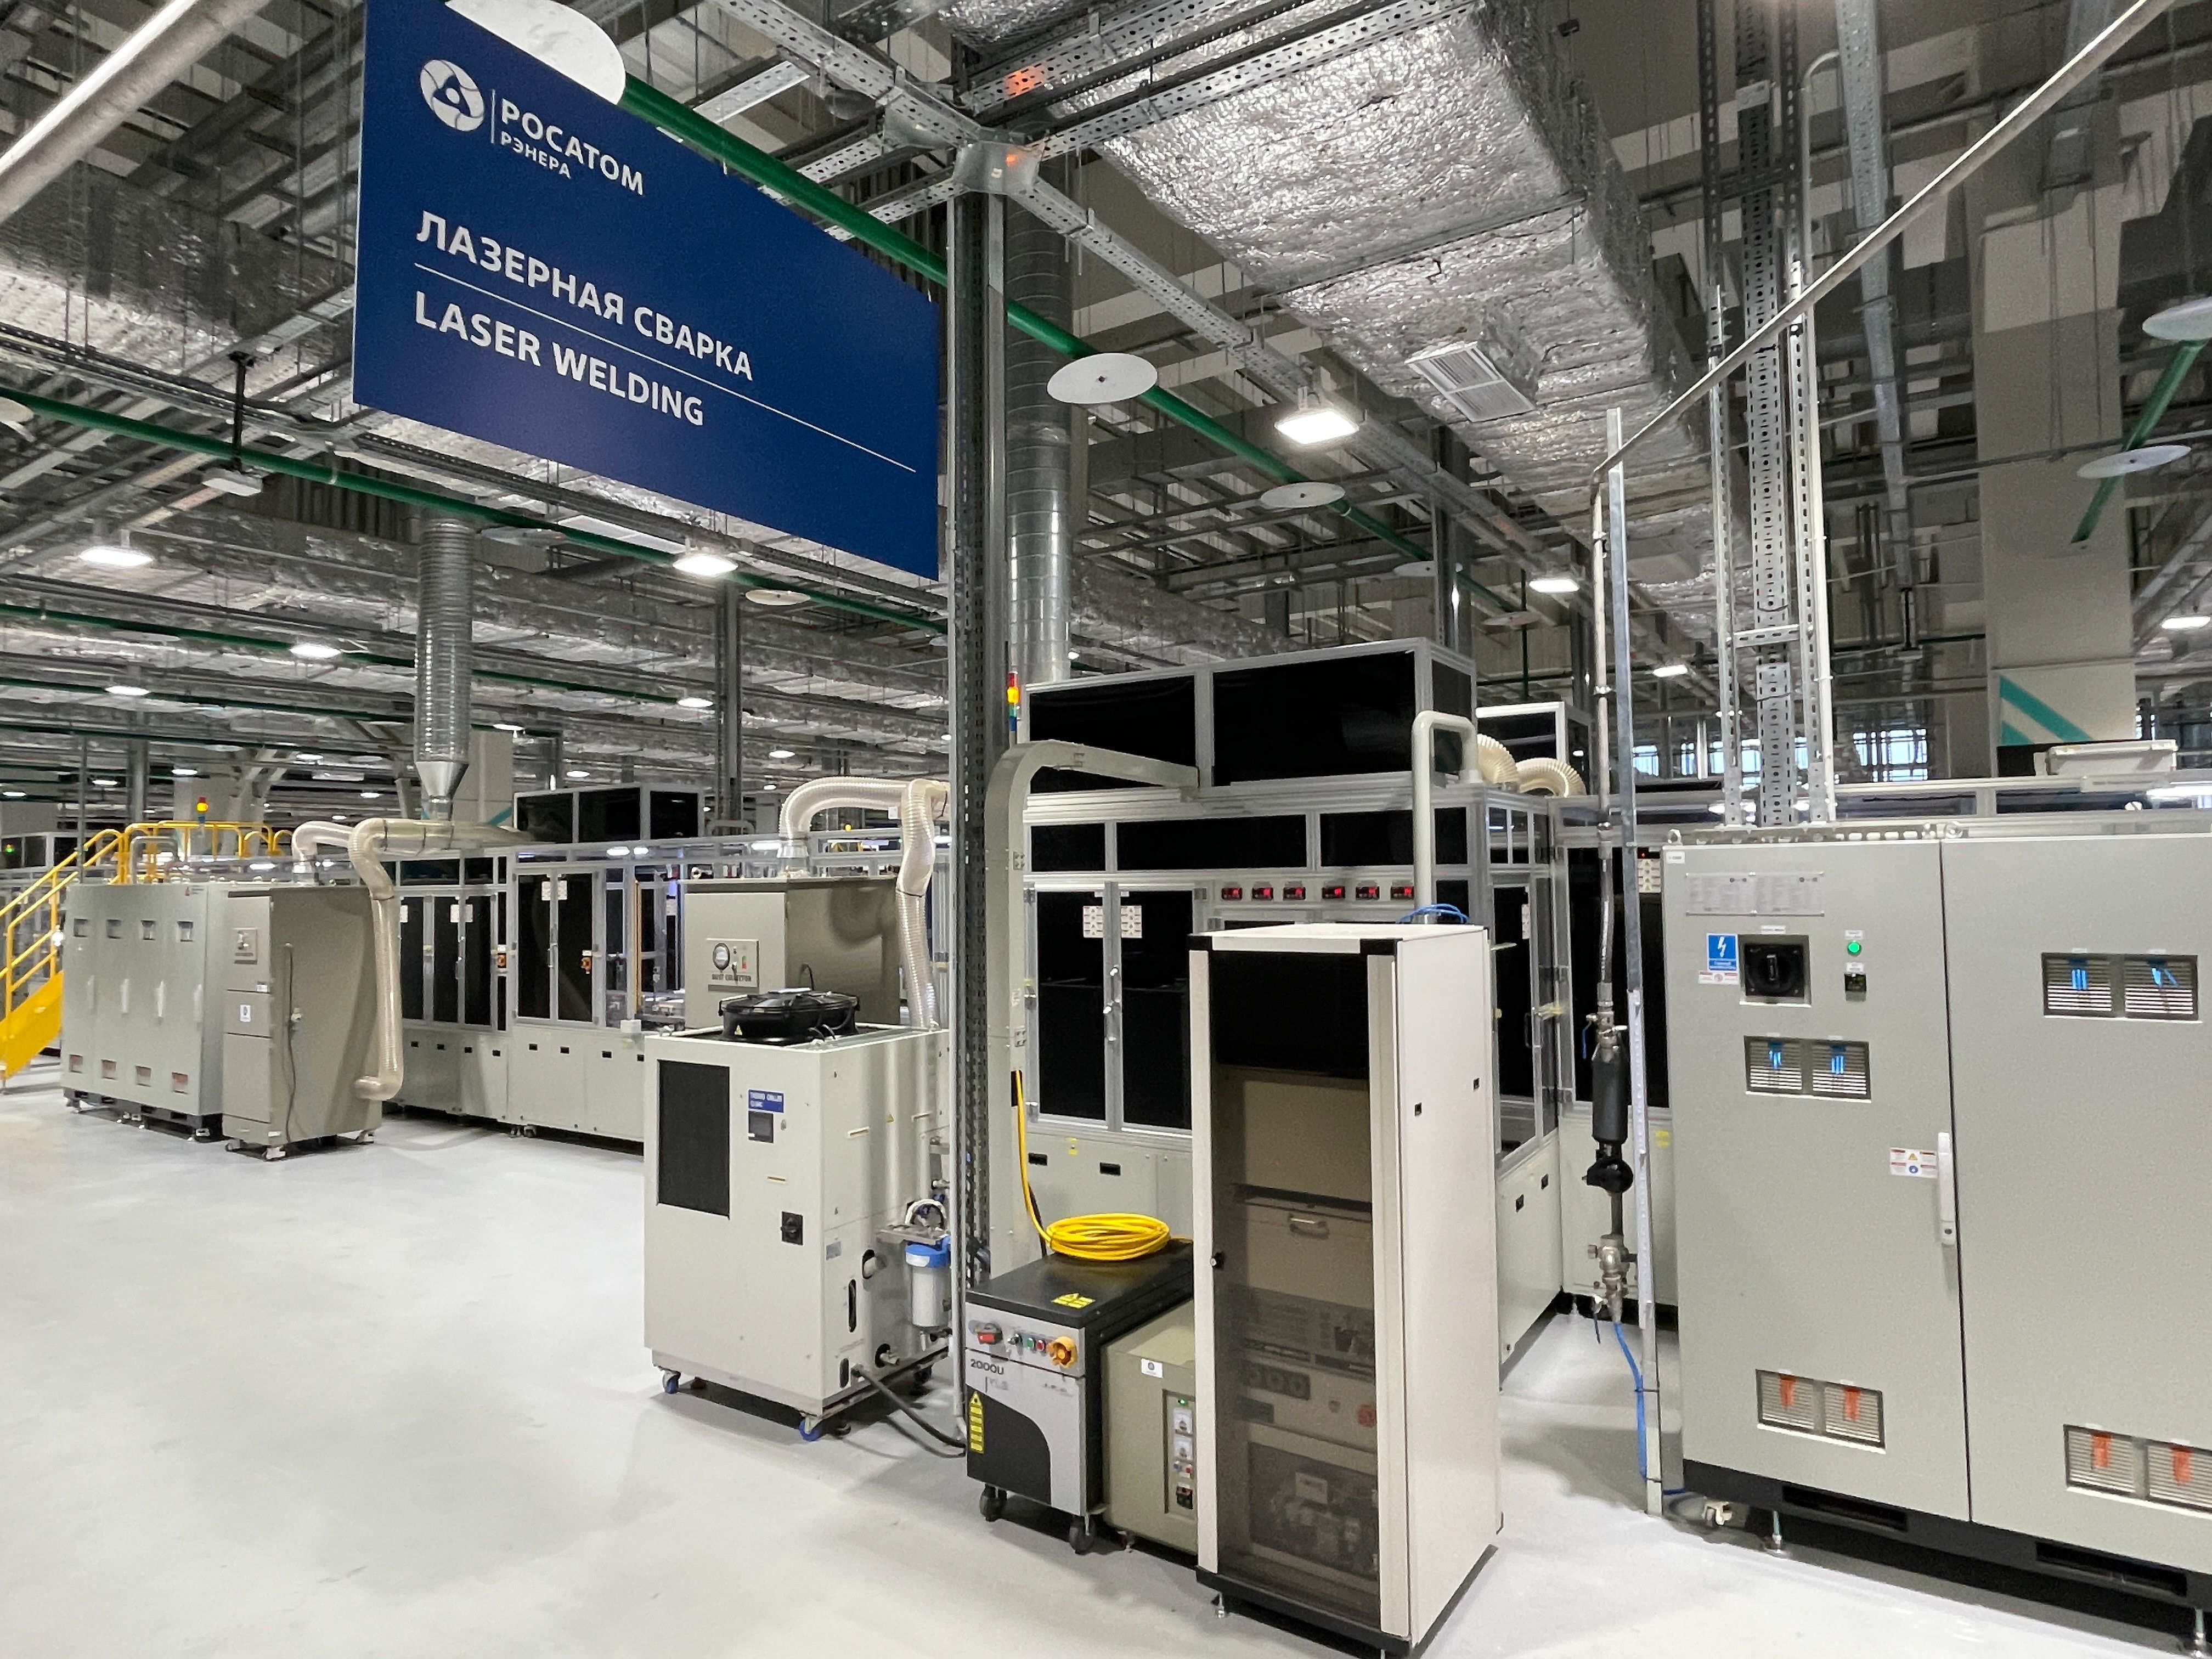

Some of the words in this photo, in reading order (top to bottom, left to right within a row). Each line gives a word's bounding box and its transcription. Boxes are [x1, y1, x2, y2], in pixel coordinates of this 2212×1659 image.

[501, 98, 643, 195] РОСАТОМ
[501, 131, 571, 179] РЭНЕРА
[416, 211, 624, 325] ЛАЗЕРНАЯ
[634, 307, 753, 381] СВАРКА
[416, 291, 541, 367] LASER
[552, 341, 703, 426] WELDING
